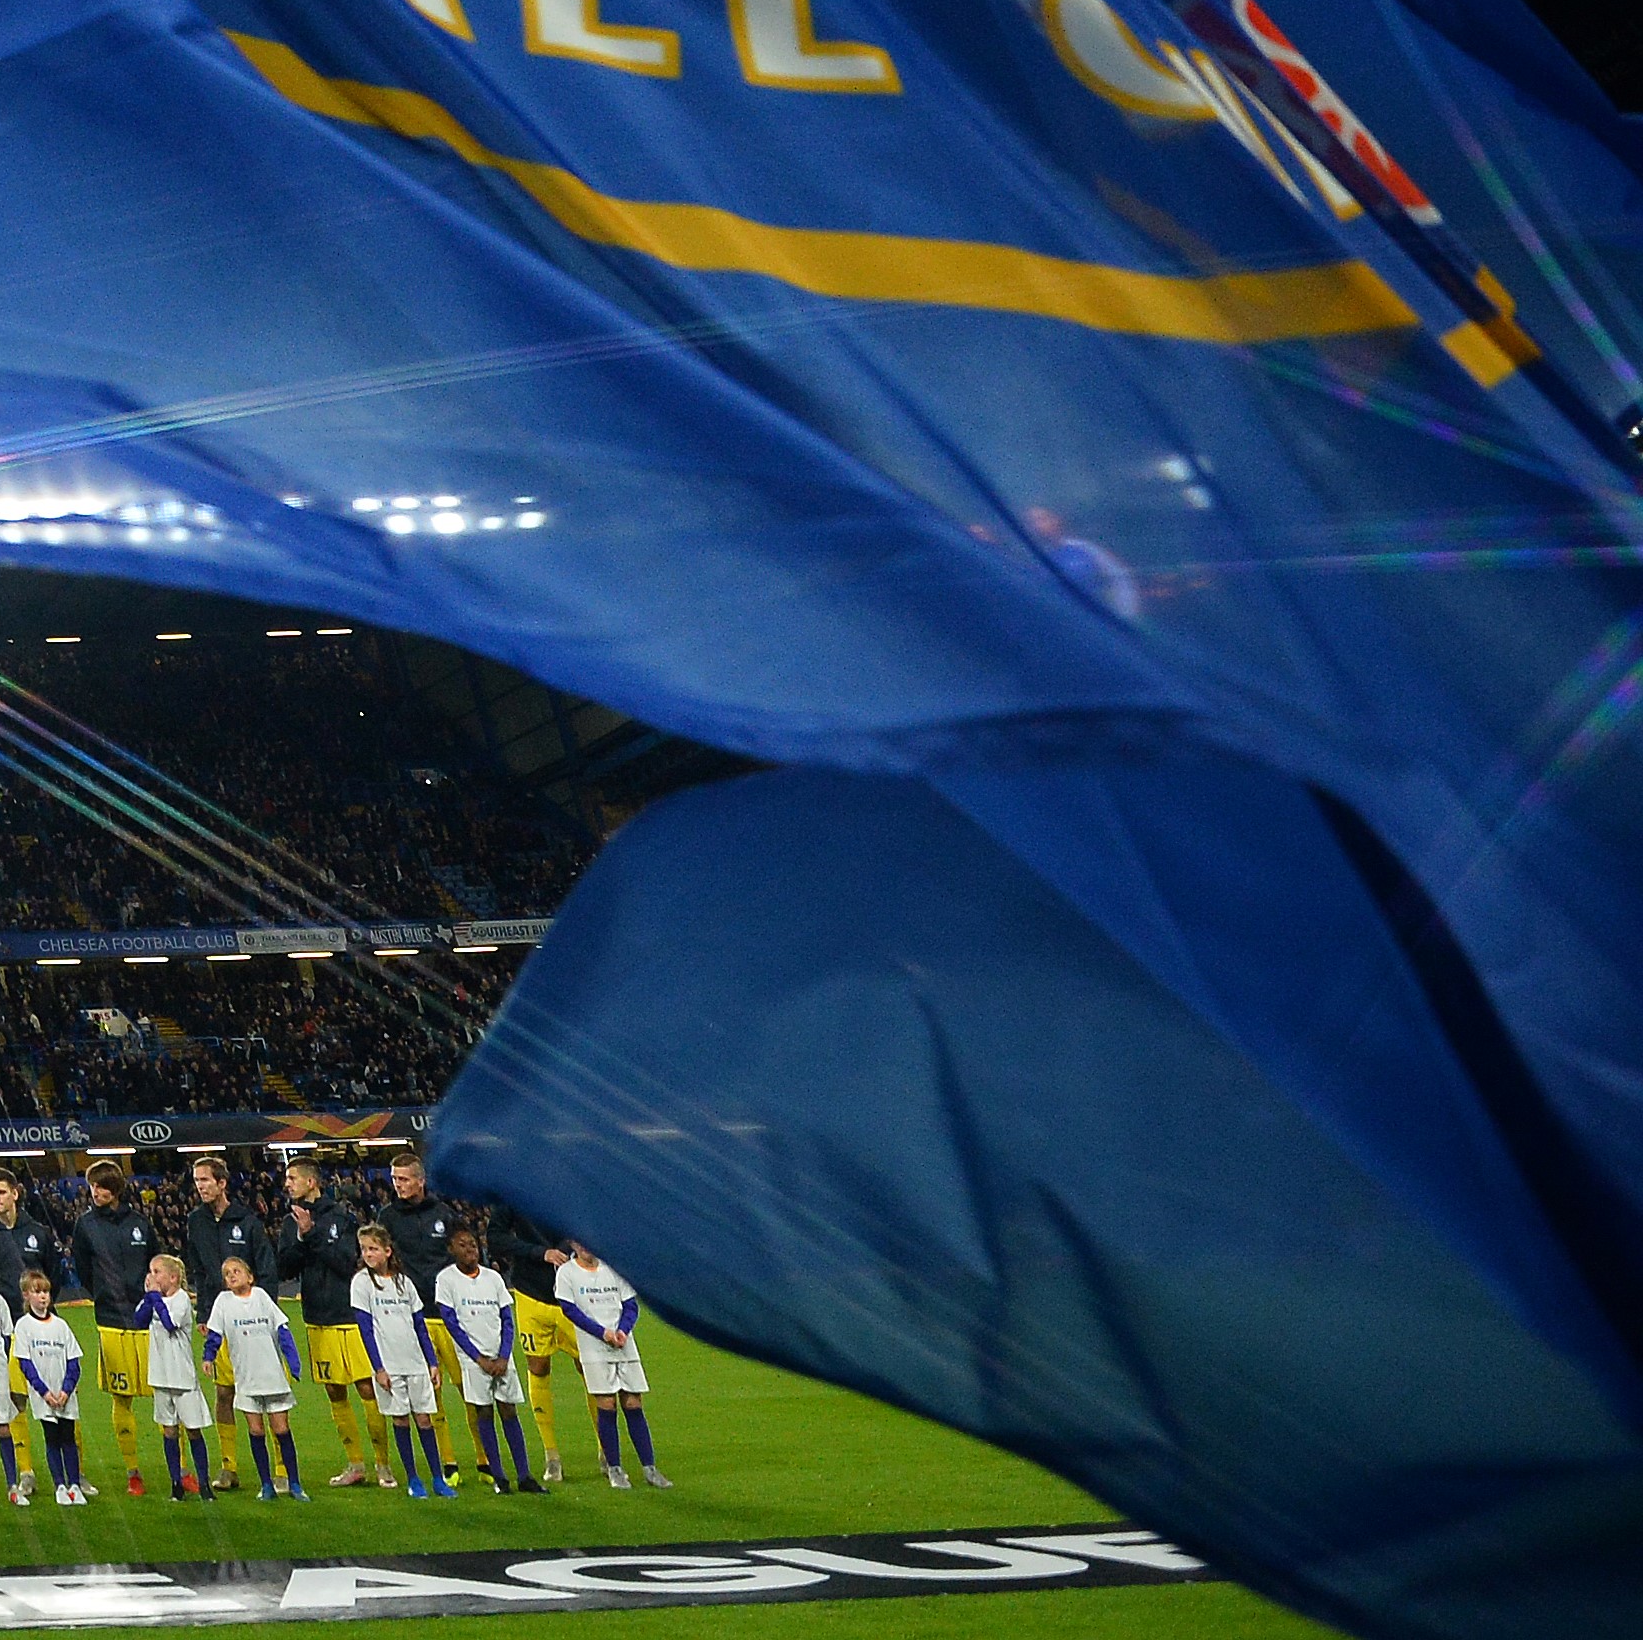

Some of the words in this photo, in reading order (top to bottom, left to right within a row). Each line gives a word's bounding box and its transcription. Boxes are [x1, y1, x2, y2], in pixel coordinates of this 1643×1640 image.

[39, 937, 109, 953] CHELSEA
[113, 935, 191, 951] FOOTBALL
[195, 934, 235, 949] CLUB
[405, 926, 432, 943] BLUES
[136, 1124, 165, 1140] KIA
[316, 1360, 331, 1381] 17
[109, 1371, 128, 1391] 25
